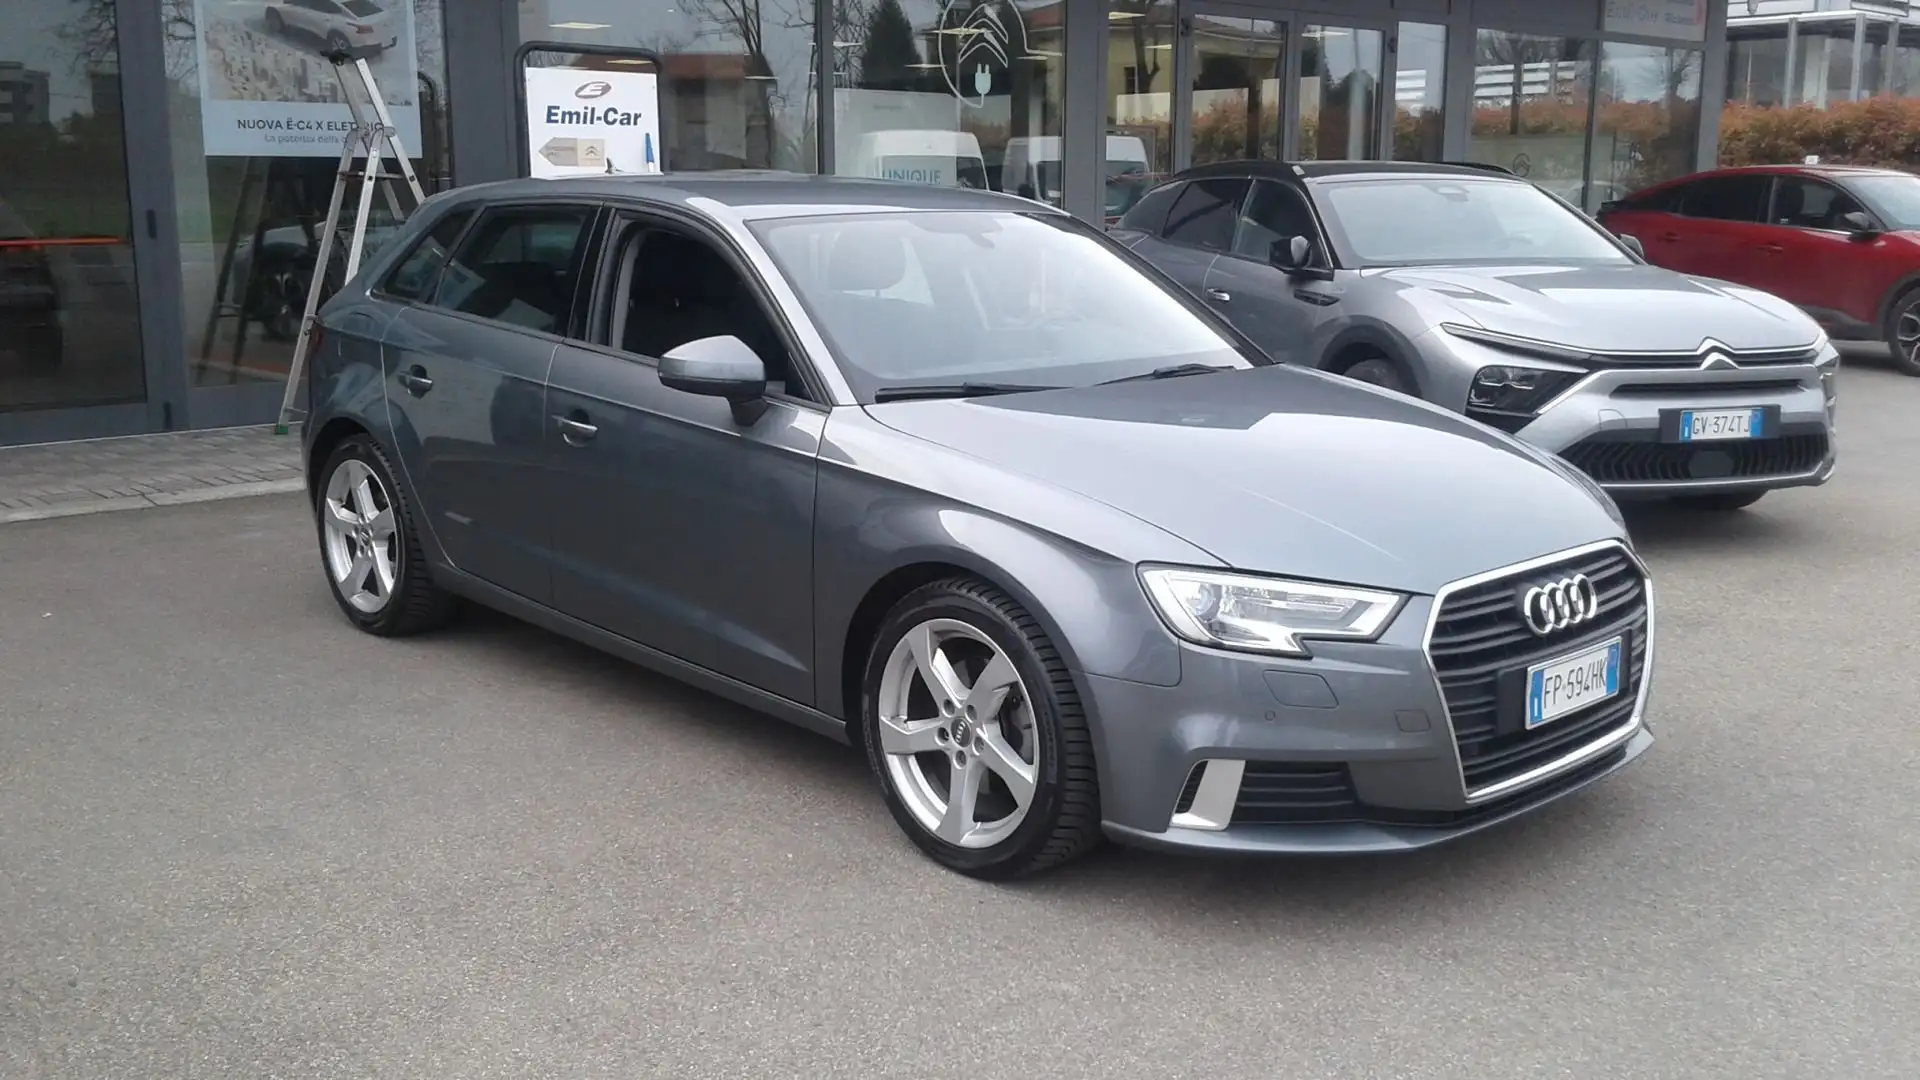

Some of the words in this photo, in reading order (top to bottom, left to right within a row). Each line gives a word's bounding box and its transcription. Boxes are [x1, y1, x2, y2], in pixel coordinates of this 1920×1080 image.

[545, 105, 642, 126] Emil-Car
[237, 119, 283, 130] NUOVA
[316, 120, 324, 131] X
[882, 169, 942, 185] UNIQUE
